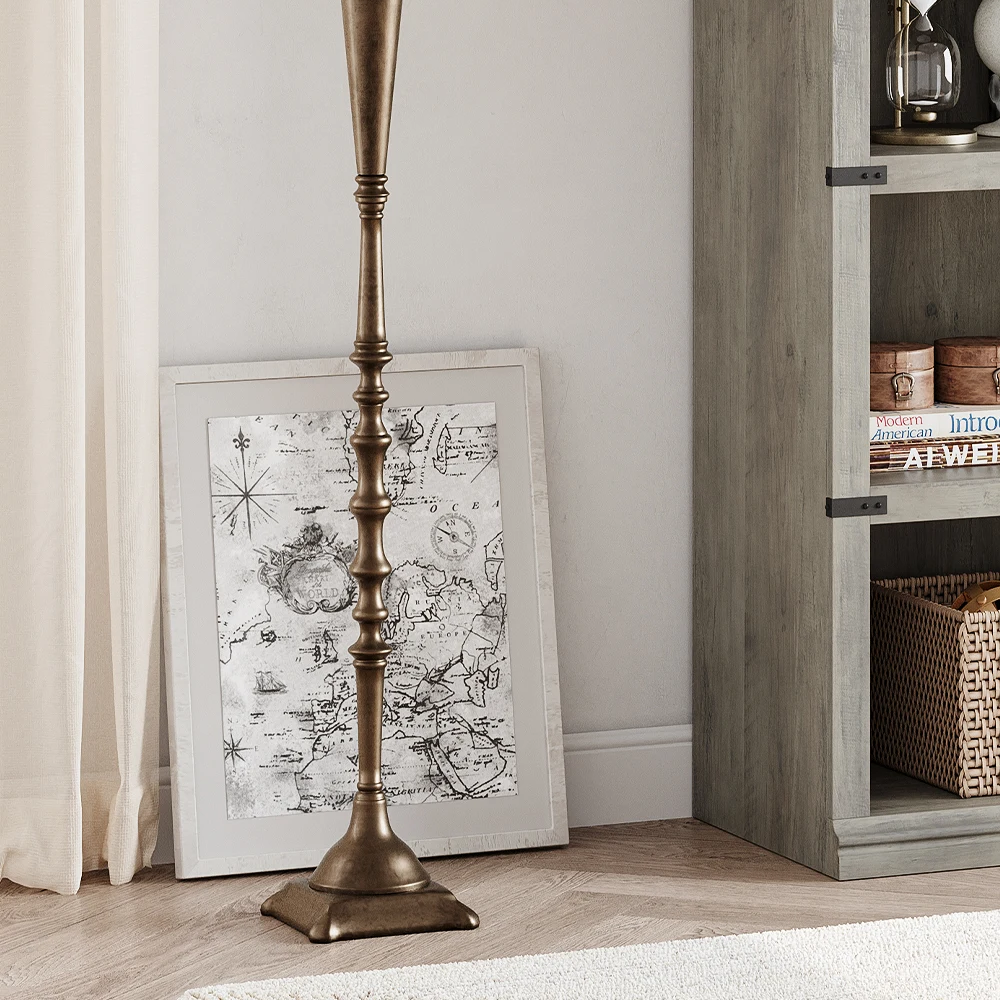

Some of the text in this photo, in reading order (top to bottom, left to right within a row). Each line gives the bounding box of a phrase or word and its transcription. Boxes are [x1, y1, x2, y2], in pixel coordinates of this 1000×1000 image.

[876, 415, 923, 427] Modern
[871, 427, 933, 440] American
[903, 447, 933, 469] AI
[295, 587, 339, 599] WORLD
